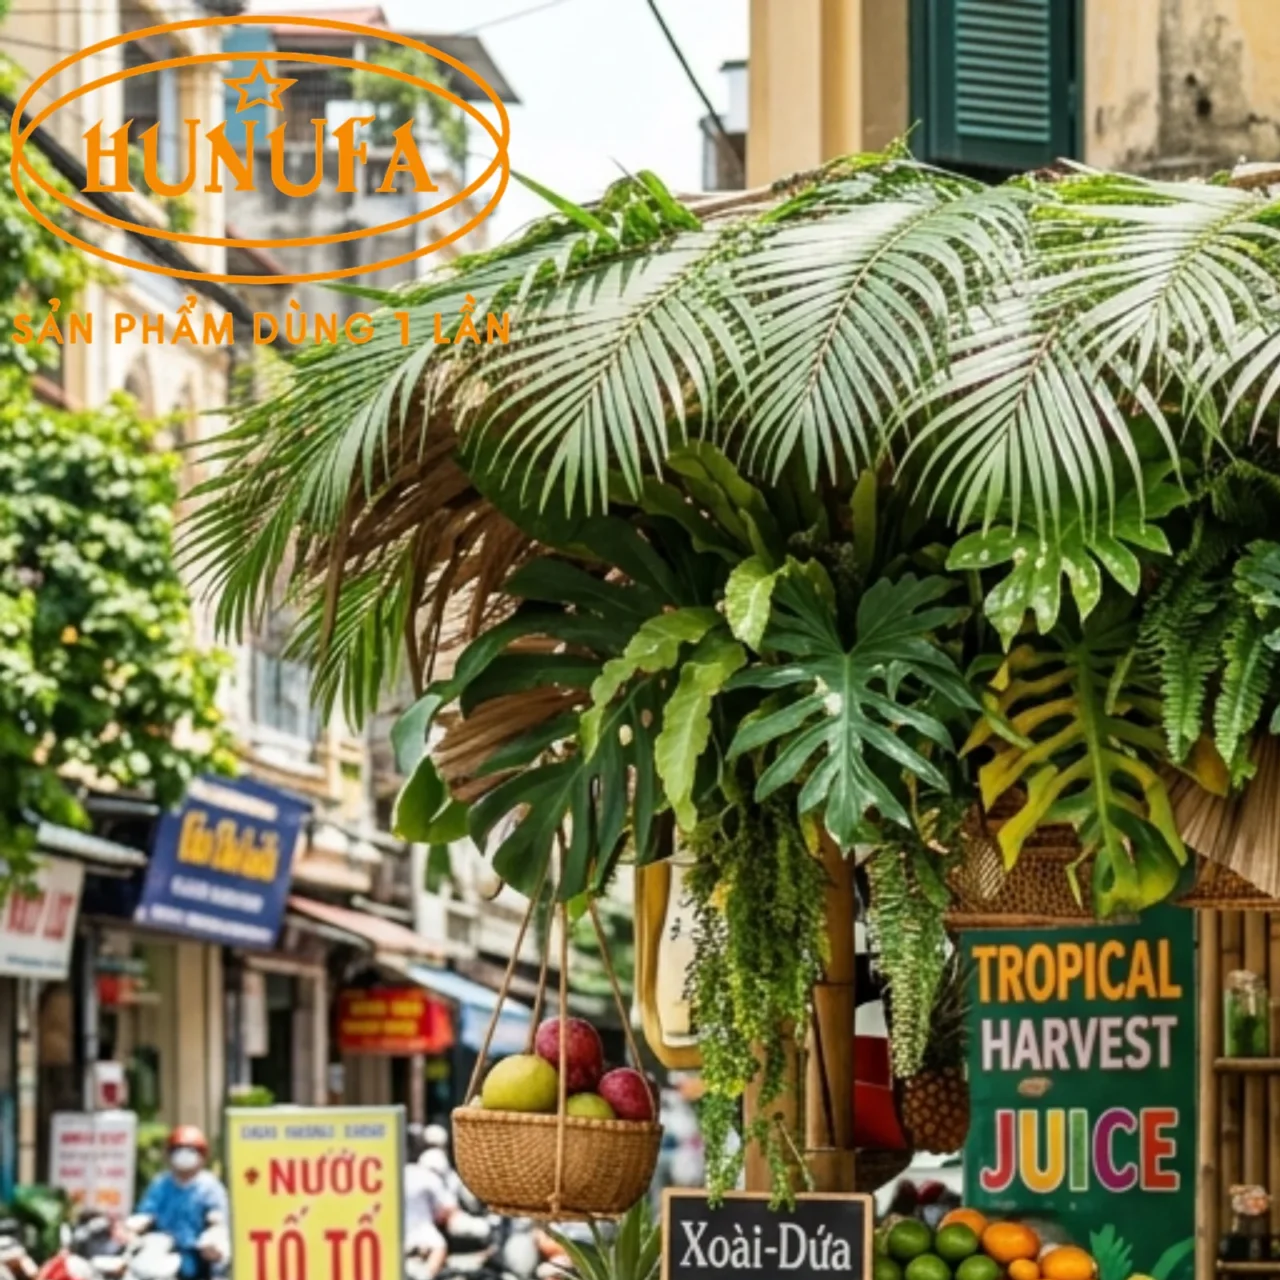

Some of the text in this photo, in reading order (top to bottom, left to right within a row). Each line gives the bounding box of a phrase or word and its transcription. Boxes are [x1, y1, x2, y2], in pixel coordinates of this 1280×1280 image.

[972, 940, 1181, 1003] TROPICAL
[981, 1016, 1179, 1072] HARVEST
[979, 1107, 1181, 1194] JUICE
[678, 1219, 853, 1272] Xoài-Dứa
